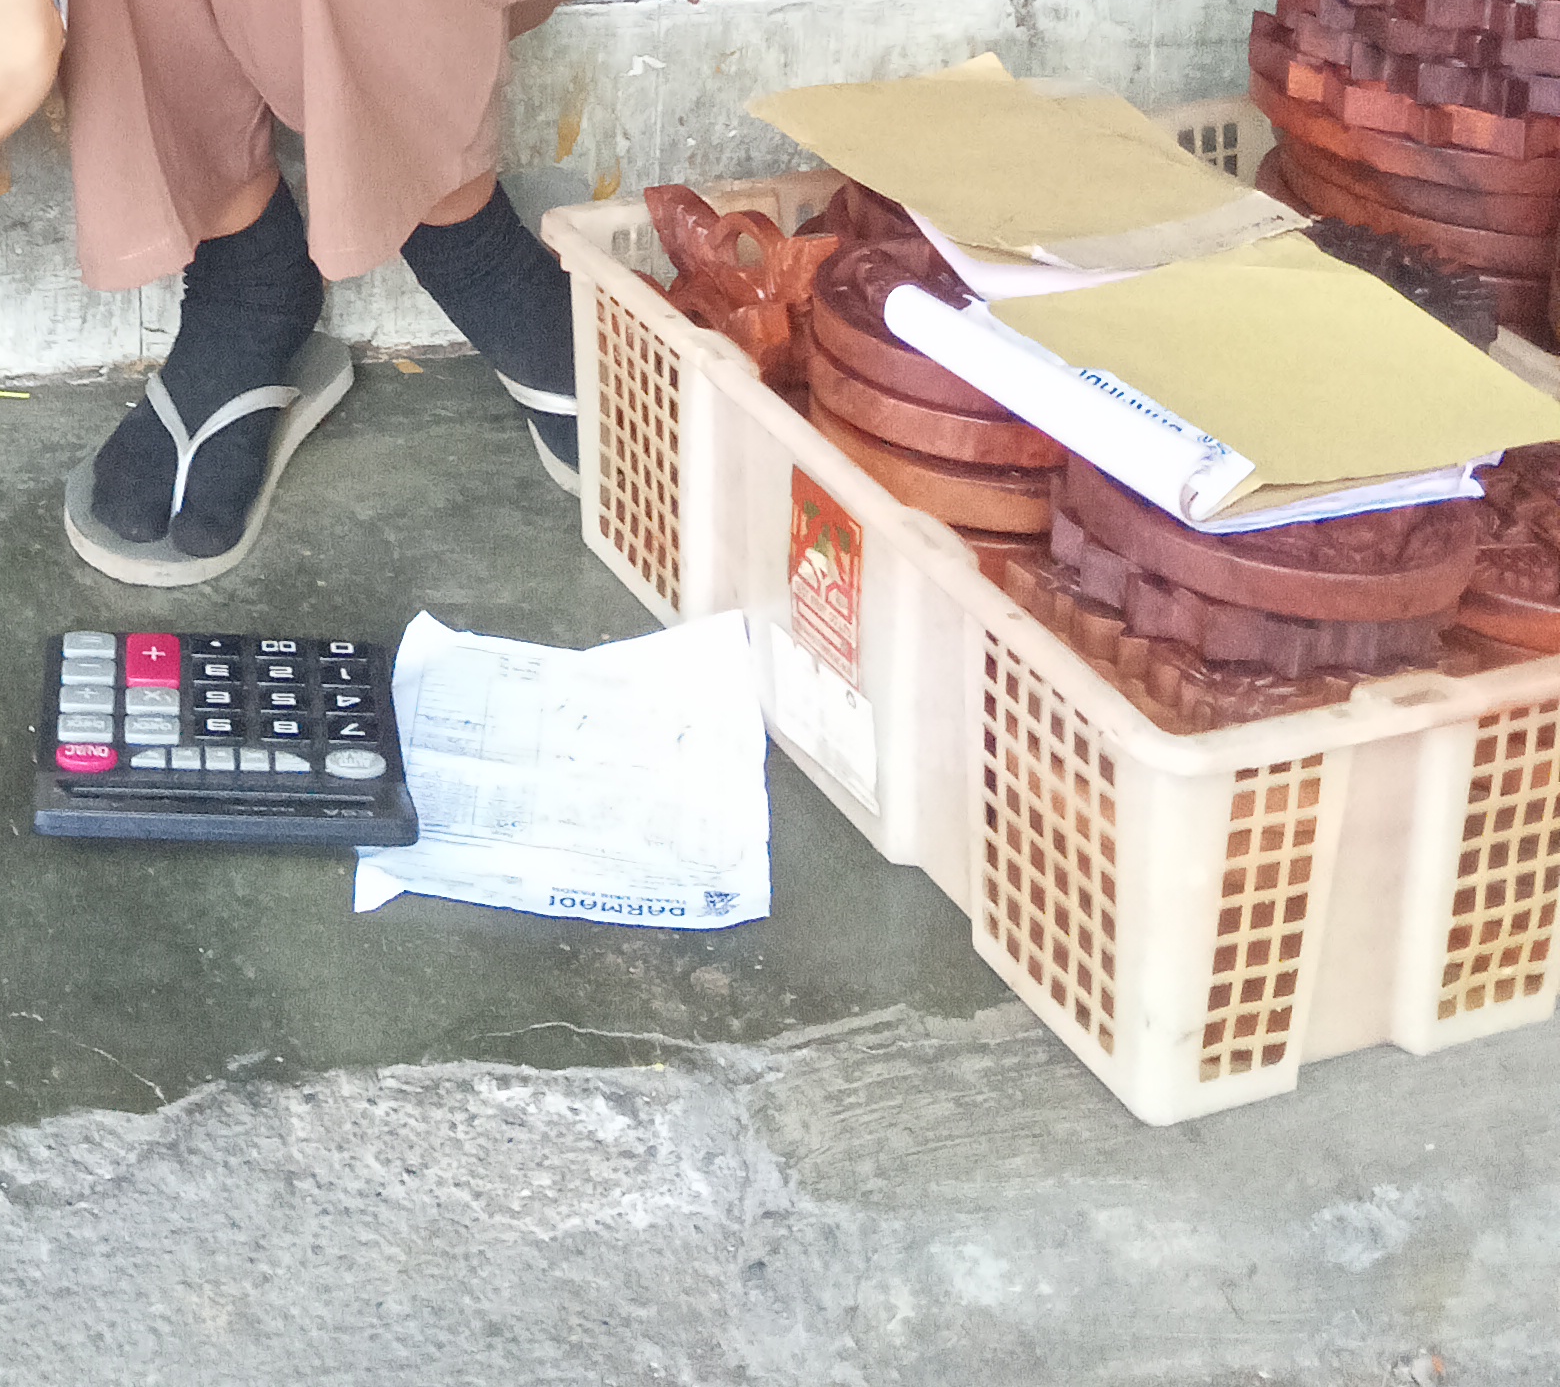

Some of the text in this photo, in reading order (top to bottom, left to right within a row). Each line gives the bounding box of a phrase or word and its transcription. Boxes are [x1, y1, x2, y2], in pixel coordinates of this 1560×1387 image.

[261, 640, 296, 653] 00
[330, 642, 354, 654] 0
[205, 664, 351, 680] 1 2 3
[206, 691, 361, 707] 4 5 6
[206, 719, 366, 736] 7 8 9
[549, 895, 686, 917] DARMADI
